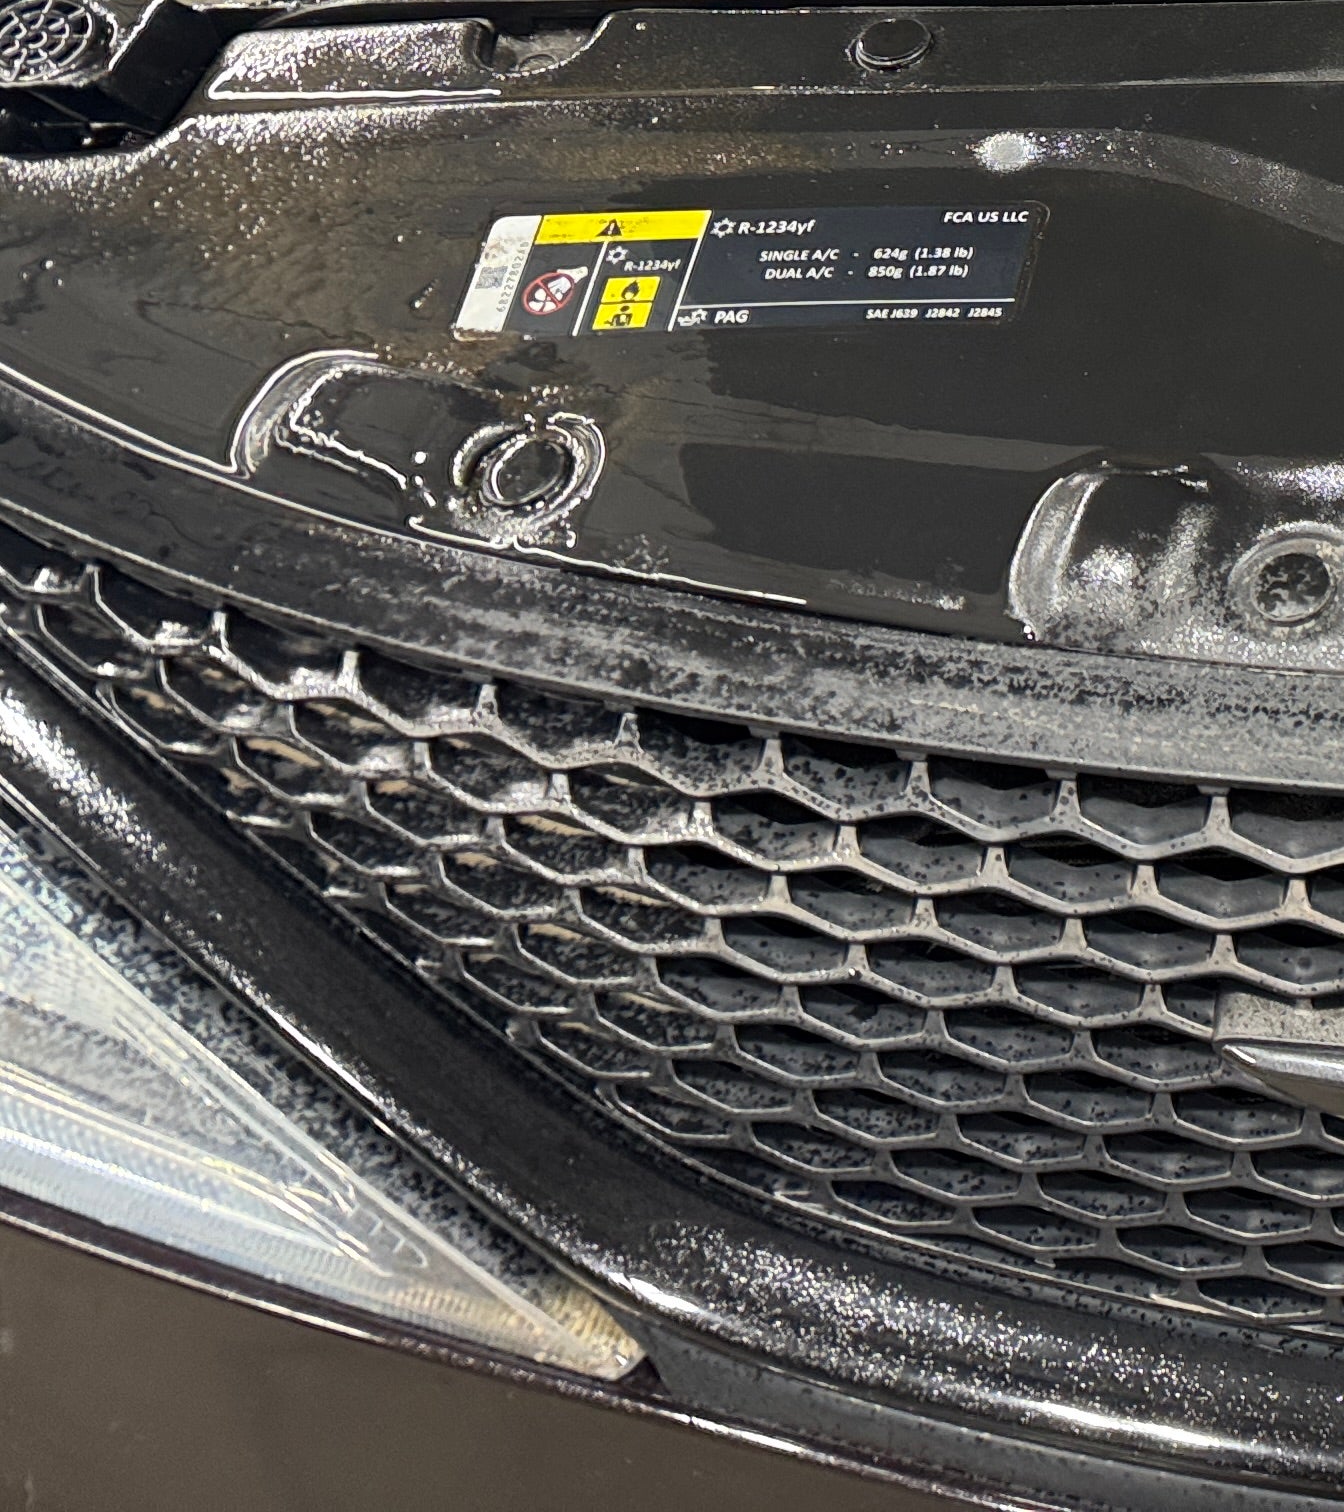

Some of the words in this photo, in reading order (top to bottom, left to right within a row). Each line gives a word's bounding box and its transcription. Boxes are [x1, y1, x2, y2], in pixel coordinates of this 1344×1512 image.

[943, 211, 973, 223] FCA
[977, 211, 999, 223] US
[1002, 210, 1029, 223] LLC
[737, 219, 816, 236] R-1234yf
[759, 250, 808, 261] SINGLE
[812, 248, 840, 261] A/C
[873, 248, 908, 261] 624g
[914, 247, 950, 260] (1.38
[954, 246, 974, 260] lb)
[624, 259, 681, 271] R-1234yf
[764, 267, 802, 279] DUAL
[806, 266, 834, 279] A/C
[867, 266, 903, 279] 850g
[909, 265, 945, 278] (1.87
[949, 264, 969, 278] lb)
[714, 309, 750, 324] PAG
[866, 309, 889, 319] SAE
[890, 308, 918, 319] J639
[925, 308, 960, 318] J2842
[967, 308, 1002, 318] J2845
